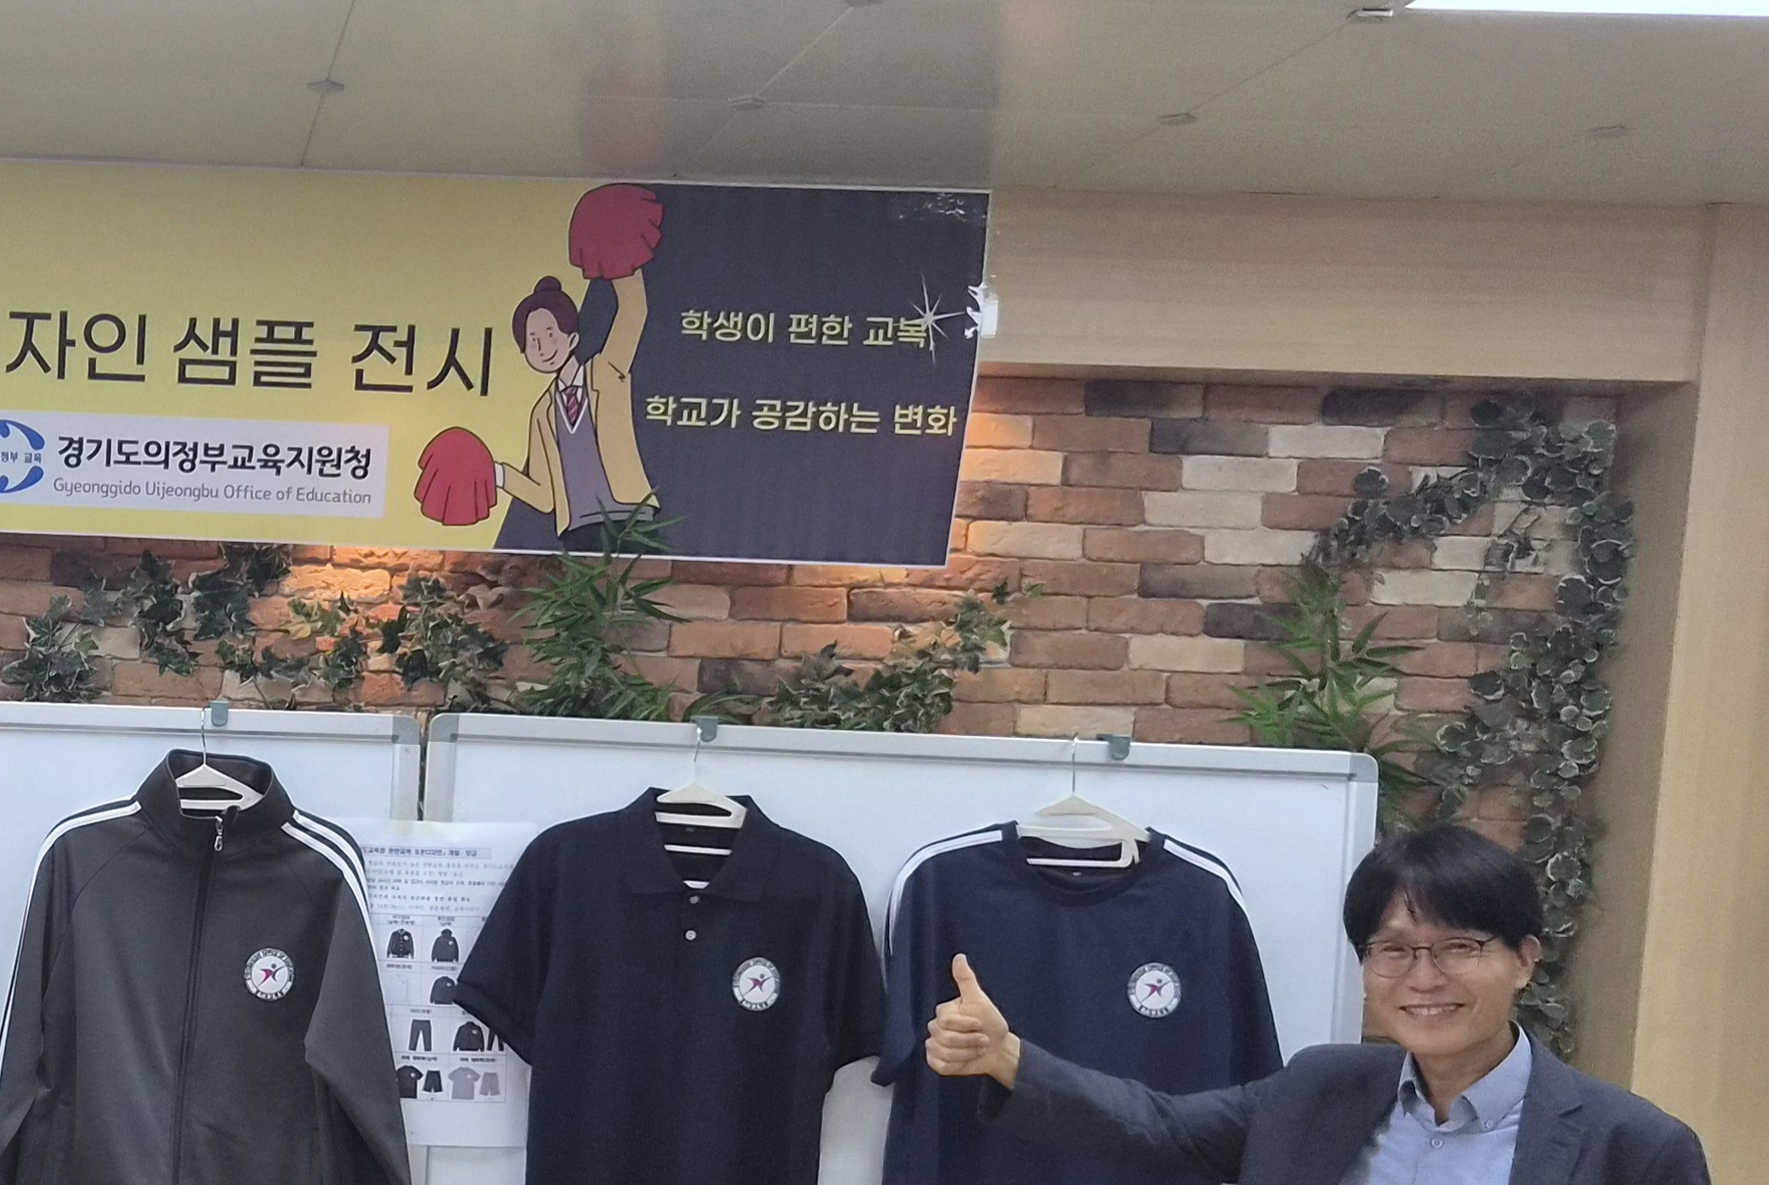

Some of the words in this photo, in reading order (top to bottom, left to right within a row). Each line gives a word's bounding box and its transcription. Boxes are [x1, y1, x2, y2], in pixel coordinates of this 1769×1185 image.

[680, 309, 775, 344] 학생이
[788, 312, 854, 346] 편한
[862, 317, 928, 349] 교복
[172, 316, 319, 391] 샘플
[350, 322, 494, 398] 전시
[645, 395, 740, 430] 학교가
[751, 398, 881, 435] 공감하는
[893, 404, 958, 438] 변화
[24, 452, 42, 464] 교육
[57, 436, 372, 480] 경기도의정부교육지원청
[53, 477, 141, 499] Gyeonggido
[145, 481, 219, 502] Uijeongbu
[223, 484, 272, 501] Office
[276, 486, 292, 502] of
[296, 487, 371, 504] Education
